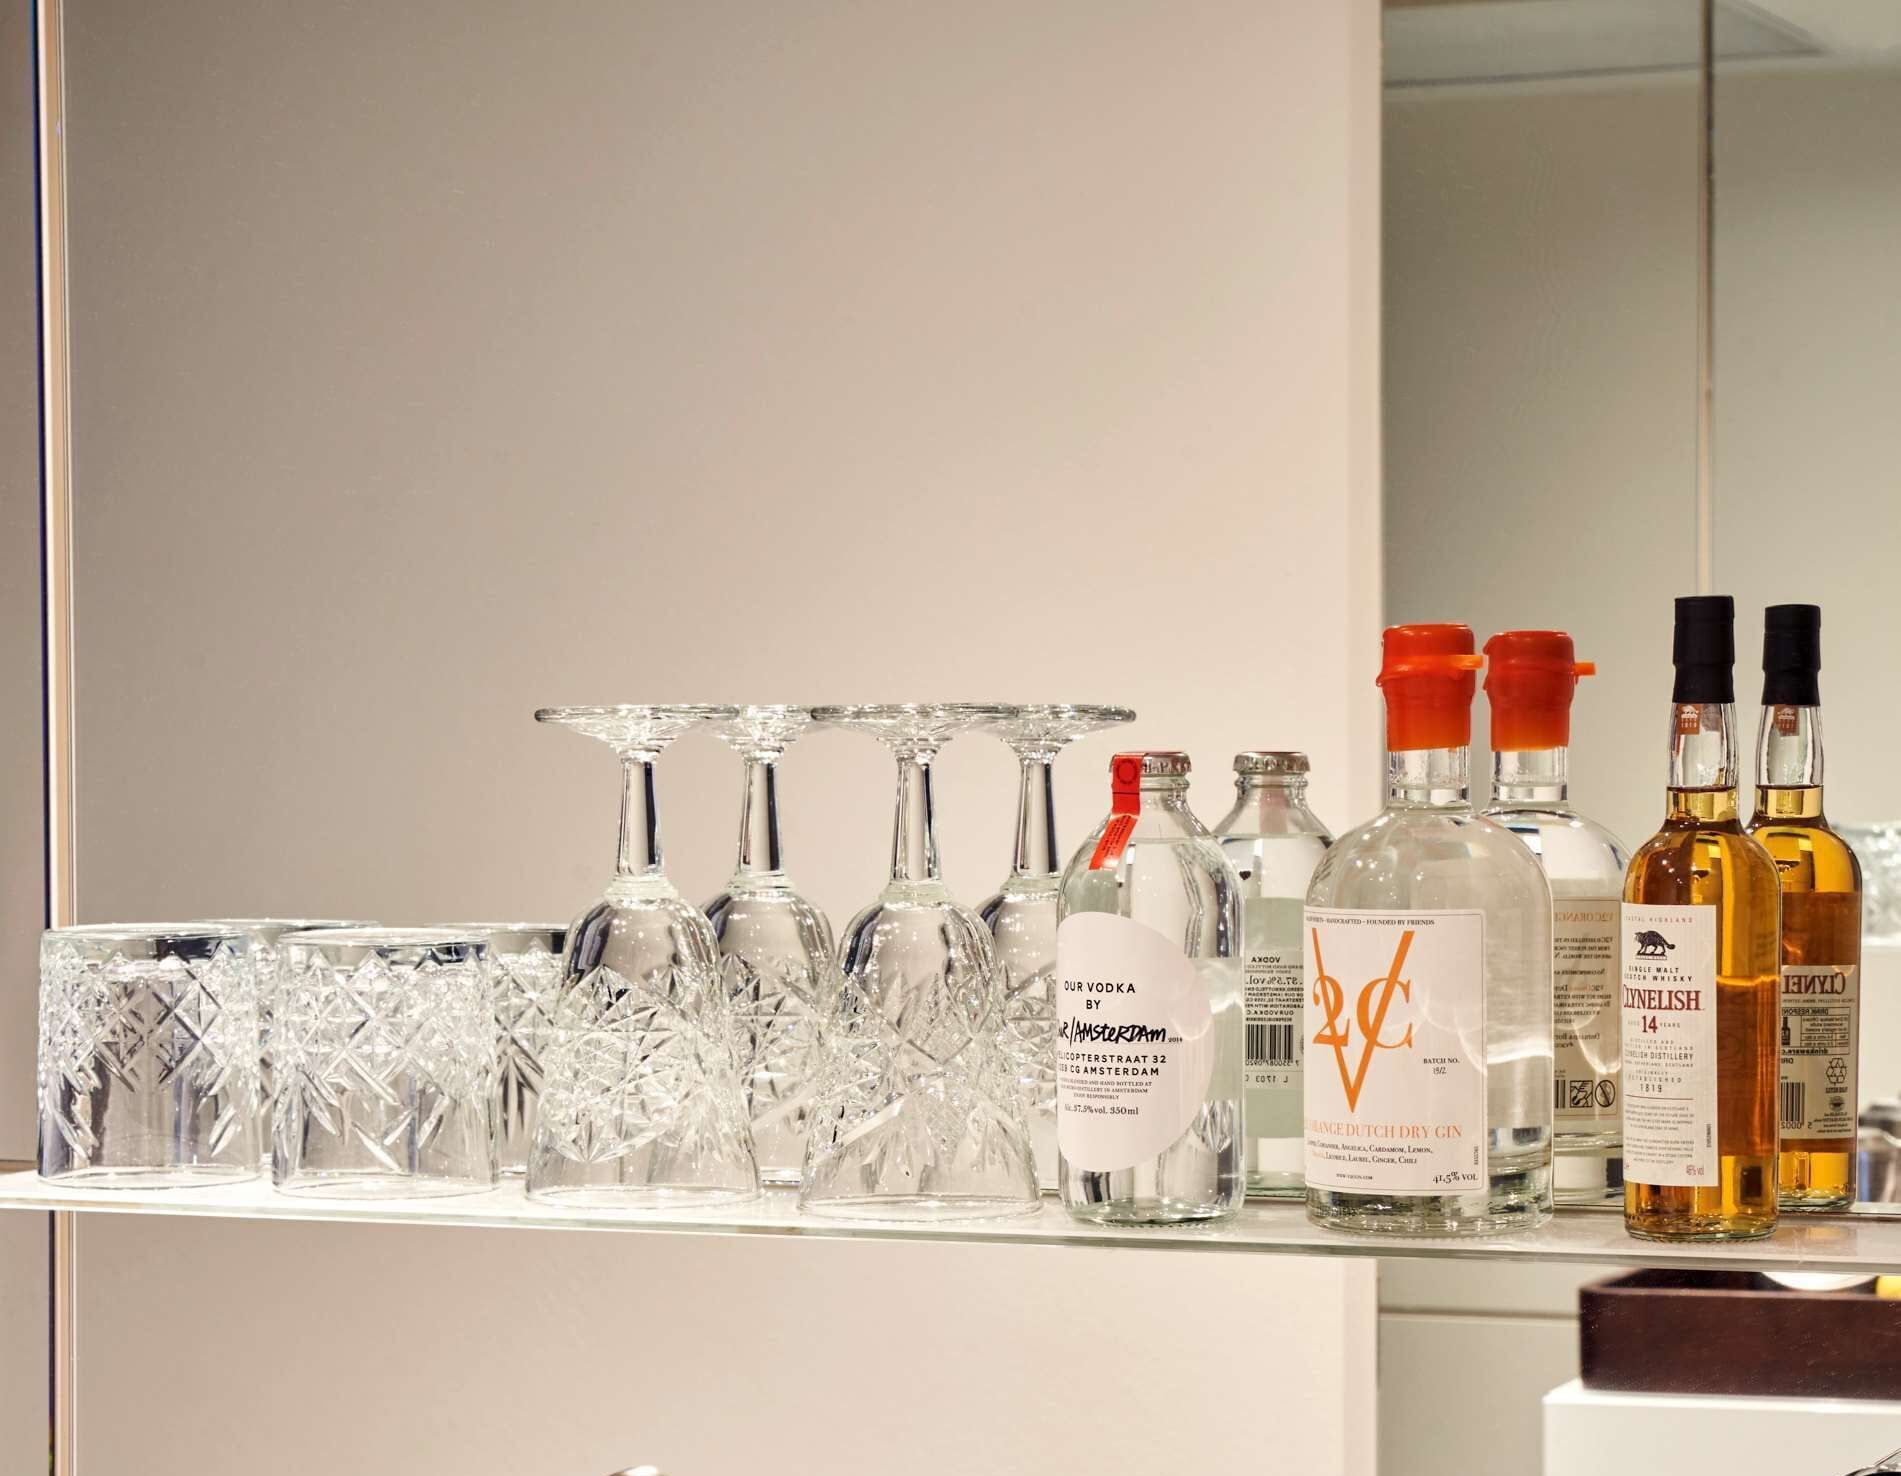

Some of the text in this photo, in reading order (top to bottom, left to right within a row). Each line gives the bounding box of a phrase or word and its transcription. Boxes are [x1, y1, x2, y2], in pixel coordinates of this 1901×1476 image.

[1064, 980, 1136, 993] OUR VODKA
[1086, 999, 1101, 1010] BY
[1642, 1015, 1658, 1034] 14
[1152, 1055, 1167, 1064] 32
[1650, 1052, 1694, 1061] DISTILLERY
[1070, 1065, 1080, 1074] CG
[1083, 1066, 1159, 1076] AMSTERDAM
[1640, 1083, 1662, 1093] 1819
[1094, 1106, 1108, 1114] vol.
[1346, 1123, 1394, 1138] DUTCH
[1399, 1125, 1431, 1139] DRY
[1434, 1125, 1462, 1138] GIN
[1369, 1144, 1407, 1154] CARDAMOM,
[1407, 1145, 1433, 1154] LEMON,
[1461, 1173, 1479, 1181] VOL
